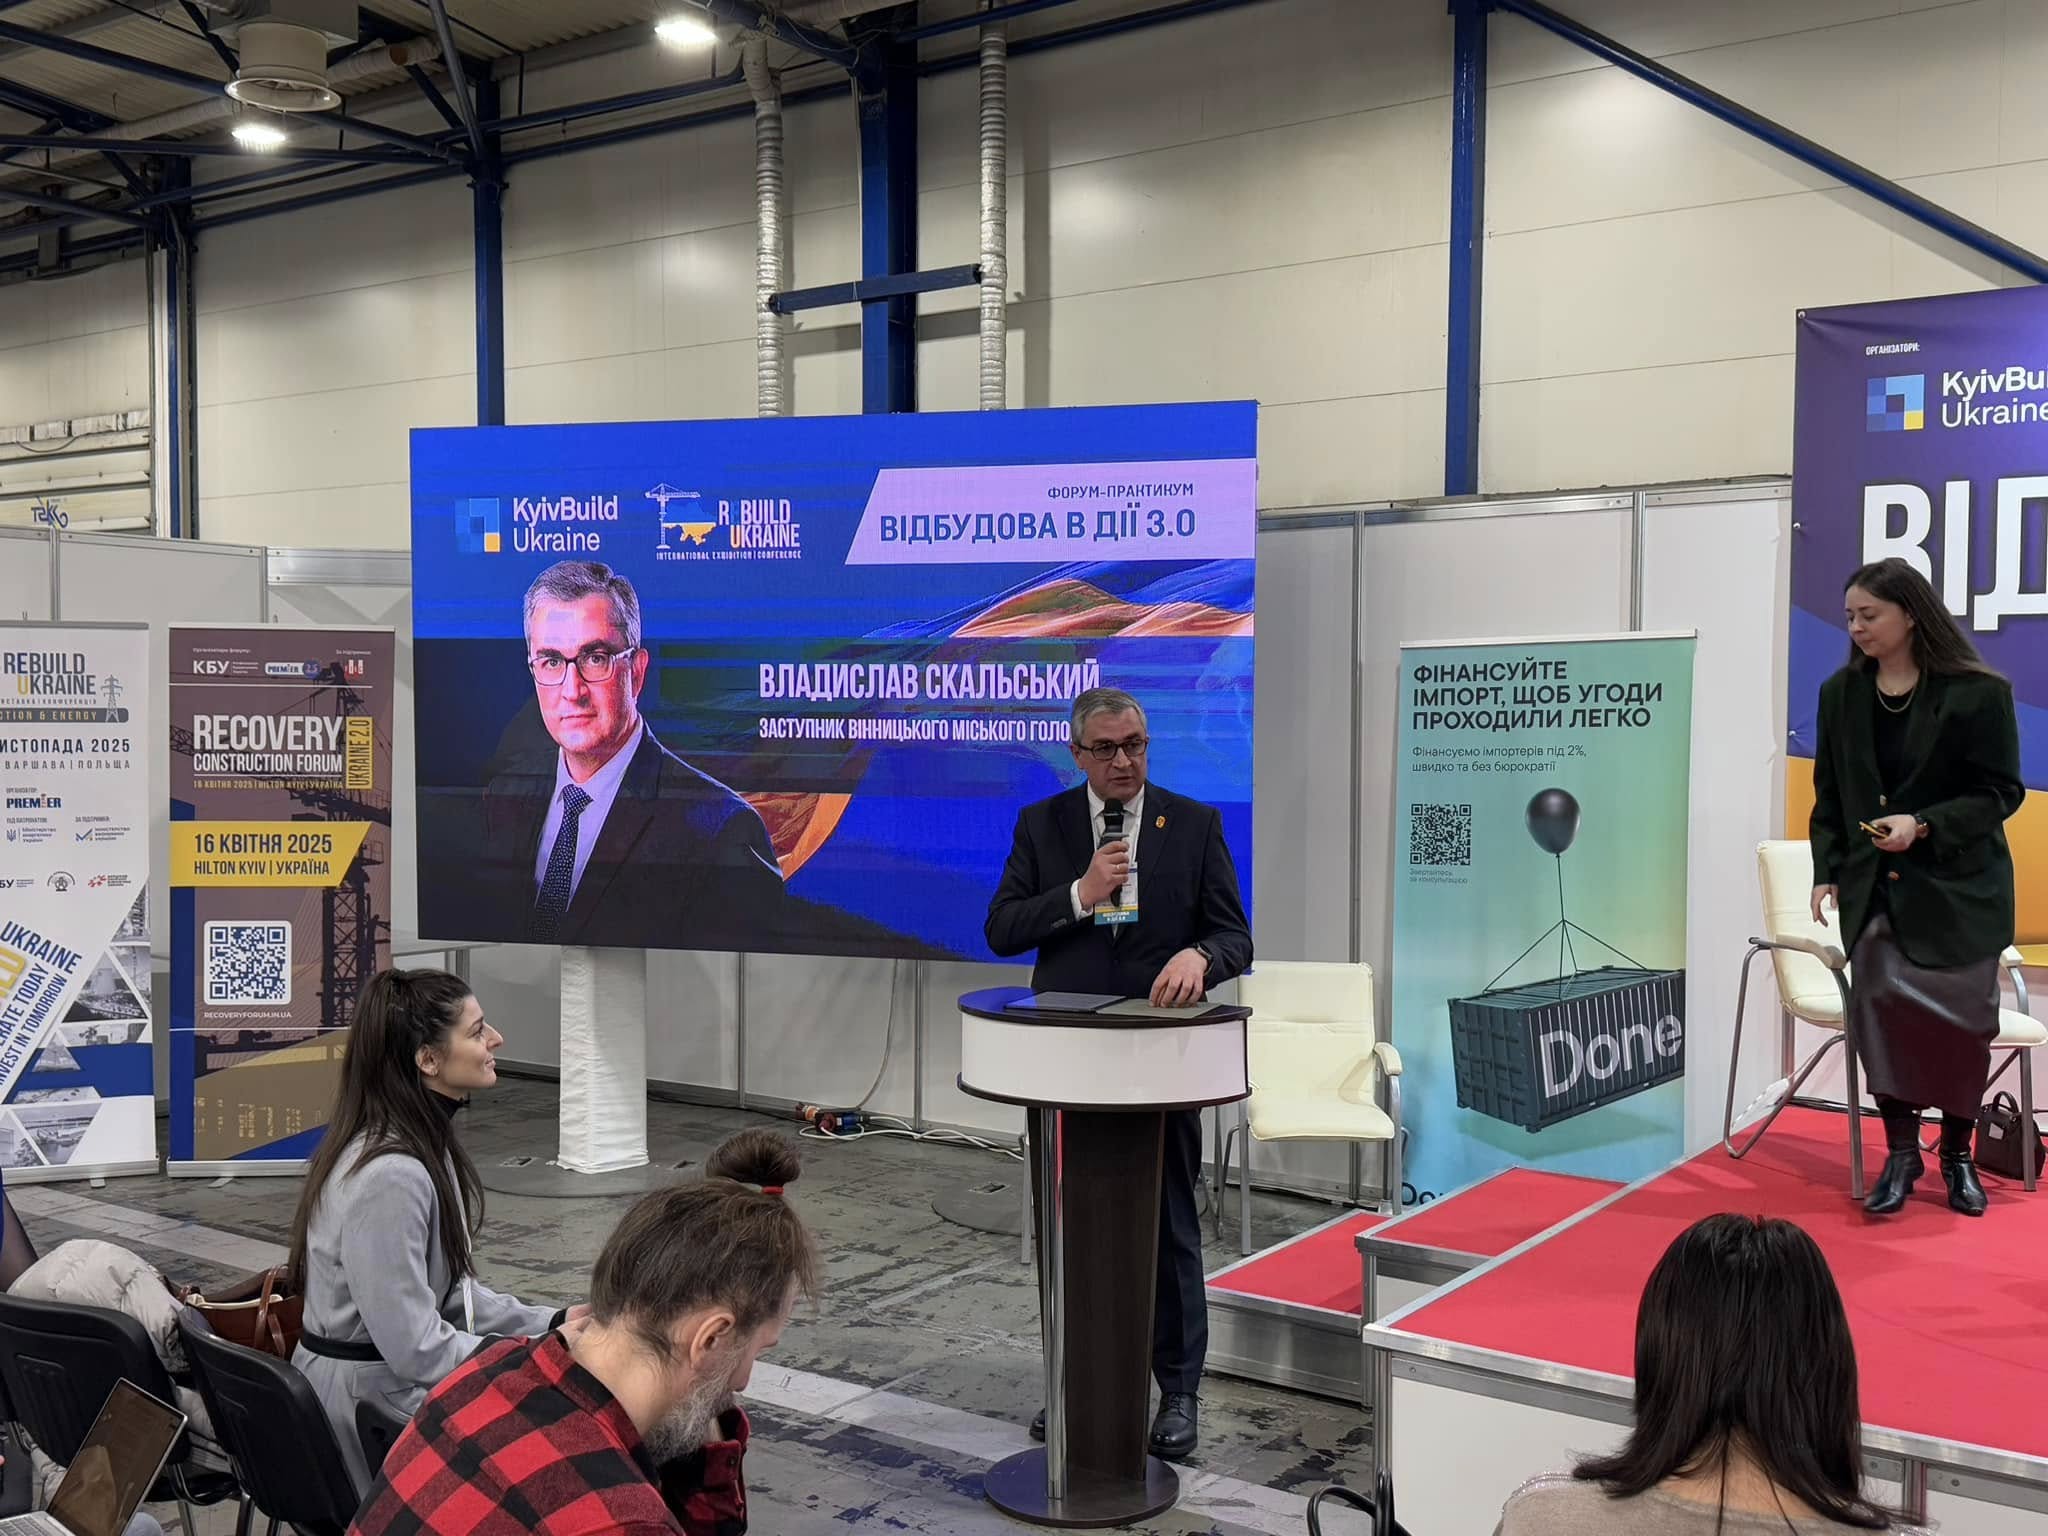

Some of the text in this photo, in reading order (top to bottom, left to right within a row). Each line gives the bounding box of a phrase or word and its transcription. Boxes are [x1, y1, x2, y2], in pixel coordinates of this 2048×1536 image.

[1866, 342, 1920, 355] ОРГАНІЗАТОРИ:
[1047, 483, 1194, 499] ФОРУМ-ПРАКТИКУМ
[513, 495, 618, 527] KyivBuild
[880, 502, 1195, 544] ВІДБУДОВА В ДІЇ 3.0
[513, 526, 600, 552] Ukraine
[730, 524, 800, 548] UKRAINE
[656, 551, 710, 560] INTERNATIONAL
[4, 652, 85, 674] REBUILD
[193, 660, 230, 674] КБУ
[1413, 657, 1567, 683] ФІНАНСУЙТЕ
[18, 675, 96, 695] UKRAINE
[759, 658, 1100, 702] ВЛАДИСЛАВ СКАЛЬСЬКИЙ
[1413, 683, 1662, 707] ІМПОРТ, ЩОБ УГОДИ
[53, 711, 97, 720] ENERGY
[1413, 708, 1651, 732] ПРОХОДИЛИ ЛЕГКО
[193, 715, 343, 750] RECOVERY
[759, 717, 1073, 743] ЗАСТУПНИК ВІННИЦЬКОГО МІСЬКОГО ГОЛО
[91, 739, 130, 753] 2025
[349, 719, 370, 786] UKRAINE 2.0
[1412, 746, 1480, 758] Фінансуємо
[1483, 746, 1544, 758] імпортерів
[1547, 746, 1565, 758] під
[5, 760, 65, 769] ВАРШАВА
[78, 760, 130, 769] ПОЛЬЩА
[194, 753, 342, 772] CONSTRUCTION FORUM
[1412, 761, 1556, 774] швидко та без бюрократії
[7, 793, 61, 808] PREMIER
[195, 834, 332, 853] 16 КВІТНЯ 2025
[194, 860, 235, 875] HILTON
[239, 860, 266, 875] KYIV
[276, 858, 330, 875] УКРАЇНА
[1, 921, 82, 974] UKRAINE
[12, 963, 49, 1005] TODAY
[21, 973, 68, 1034] TOMORROW
[13, 1032, 31, 1048] IN
[1539, 1014, 1682, 1099] Done
